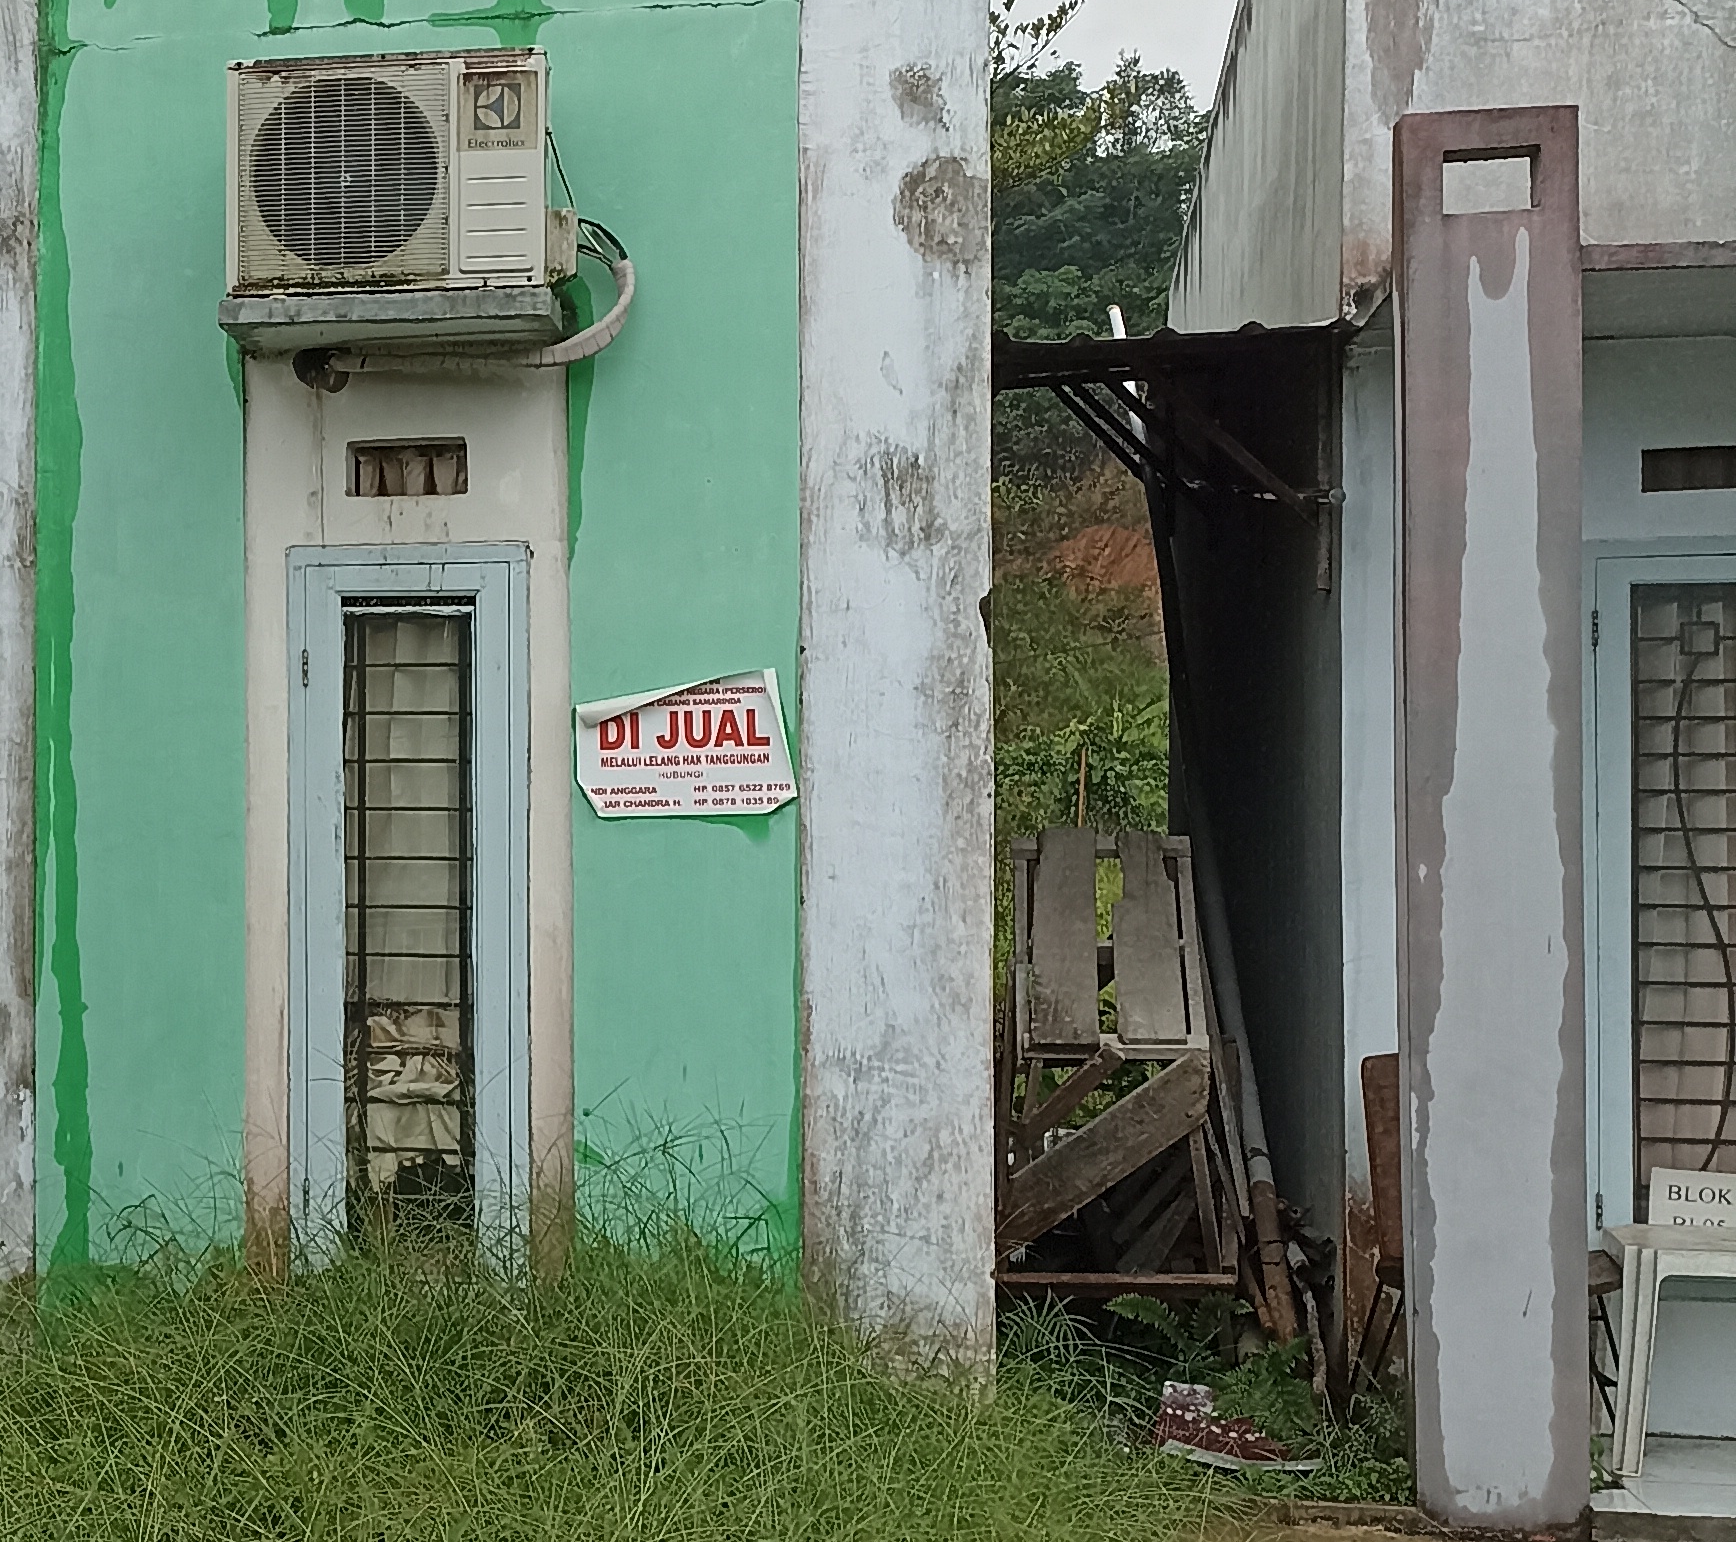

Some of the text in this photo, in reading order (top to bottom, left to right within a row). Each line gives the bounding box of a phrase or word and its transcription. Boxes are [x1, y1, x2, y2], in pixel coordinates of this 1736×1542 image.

[467, 138, 526, 149] Electrolux
[657, 699, 690, 707] CABANG
[693, 698, 741, 706] SAMARINDA
[599, 709, 770, 751] DI JUAL
[601, 753, 769, 768] MELALUI LELANG HAK TANGGUNGAN
[610, 786, 657, 795] ANGGARA
[624, 799, 670, 808] CHANDRA
[1667, 1185, 1733, 1205] BLOK
